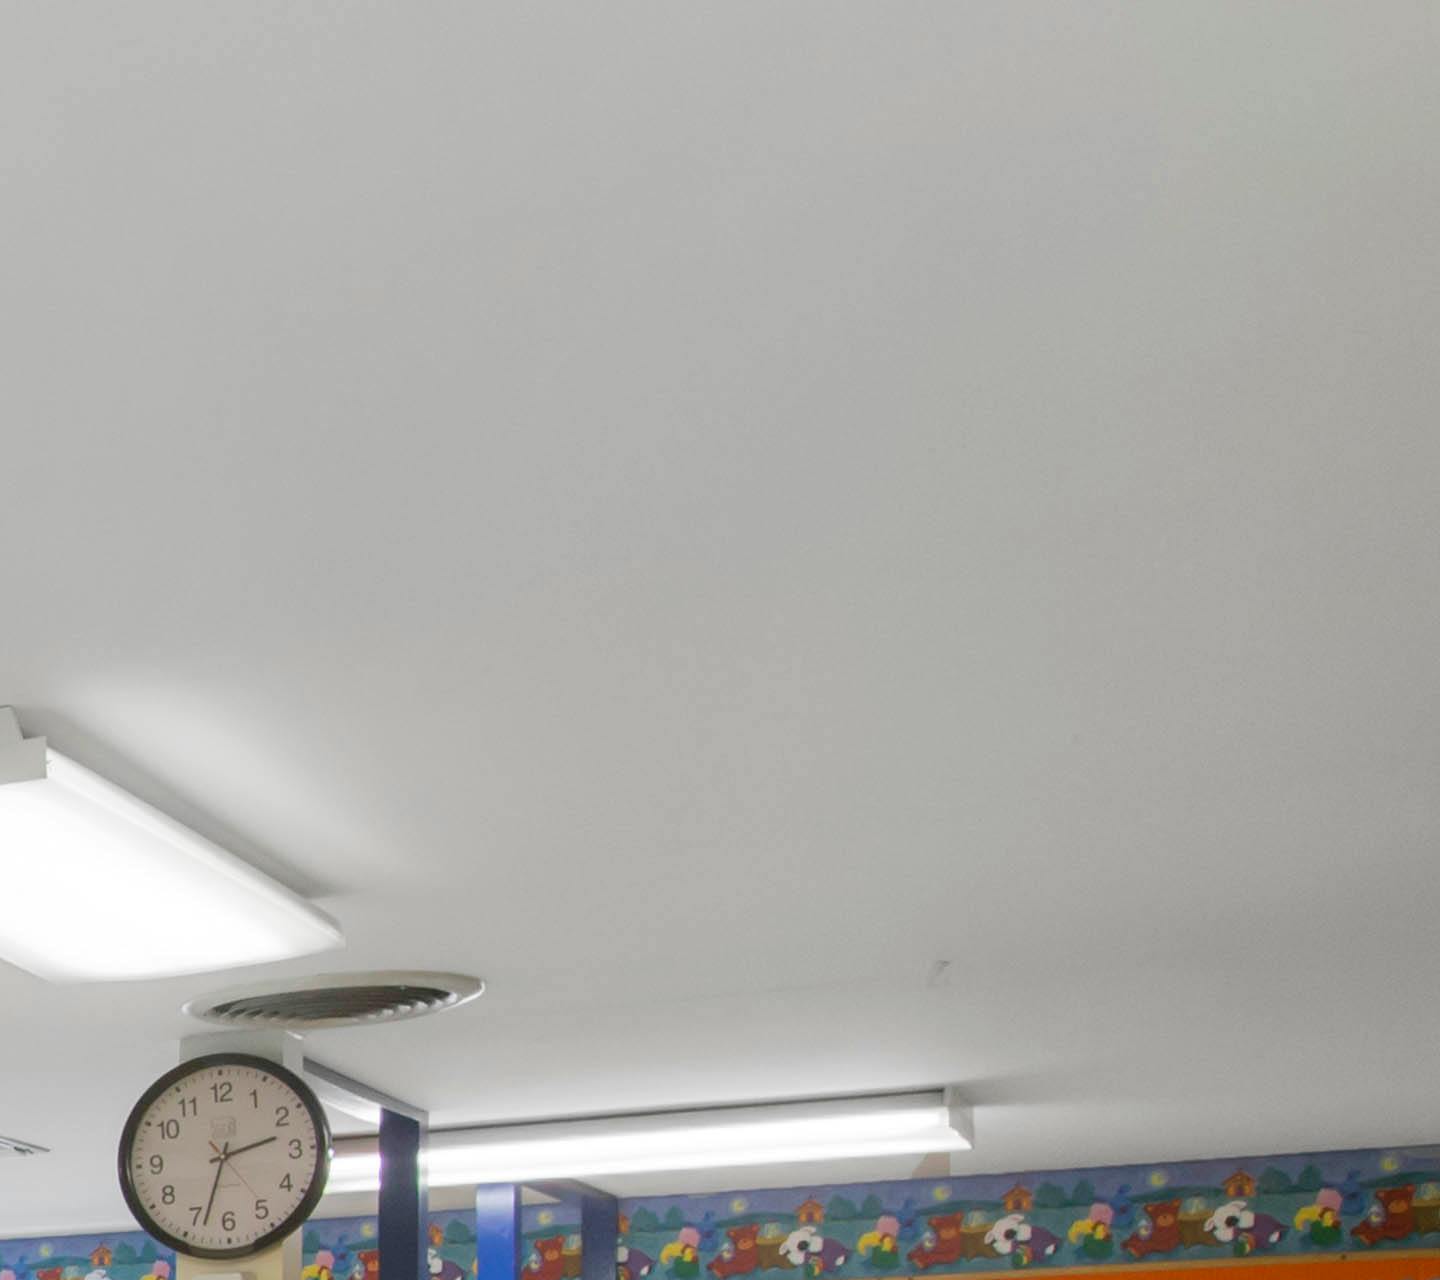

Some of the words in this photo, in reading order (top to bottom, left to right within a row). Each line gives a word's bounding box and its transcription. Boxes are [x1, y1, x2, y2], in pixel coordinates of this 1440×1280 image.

[210, 1082, 233, 1103] 12
[249, 1089, 259, 1109] 1
[178, 1096, 198, 1117] 11
[275, 1106, 290, 1127] 2
[158, 1119, 180, 1140] 10
[288, 1139, 303, 1159] 3
[149, 1155, 164, 1175] 9
[279, 1173, 294, 1192] 4
[161, 1185, 176, 1205] 8
[189, 1206, 203, 1227] 7
[254, 1199, 269, 1220] 5
[221, 1211, 236, 1231] 6
